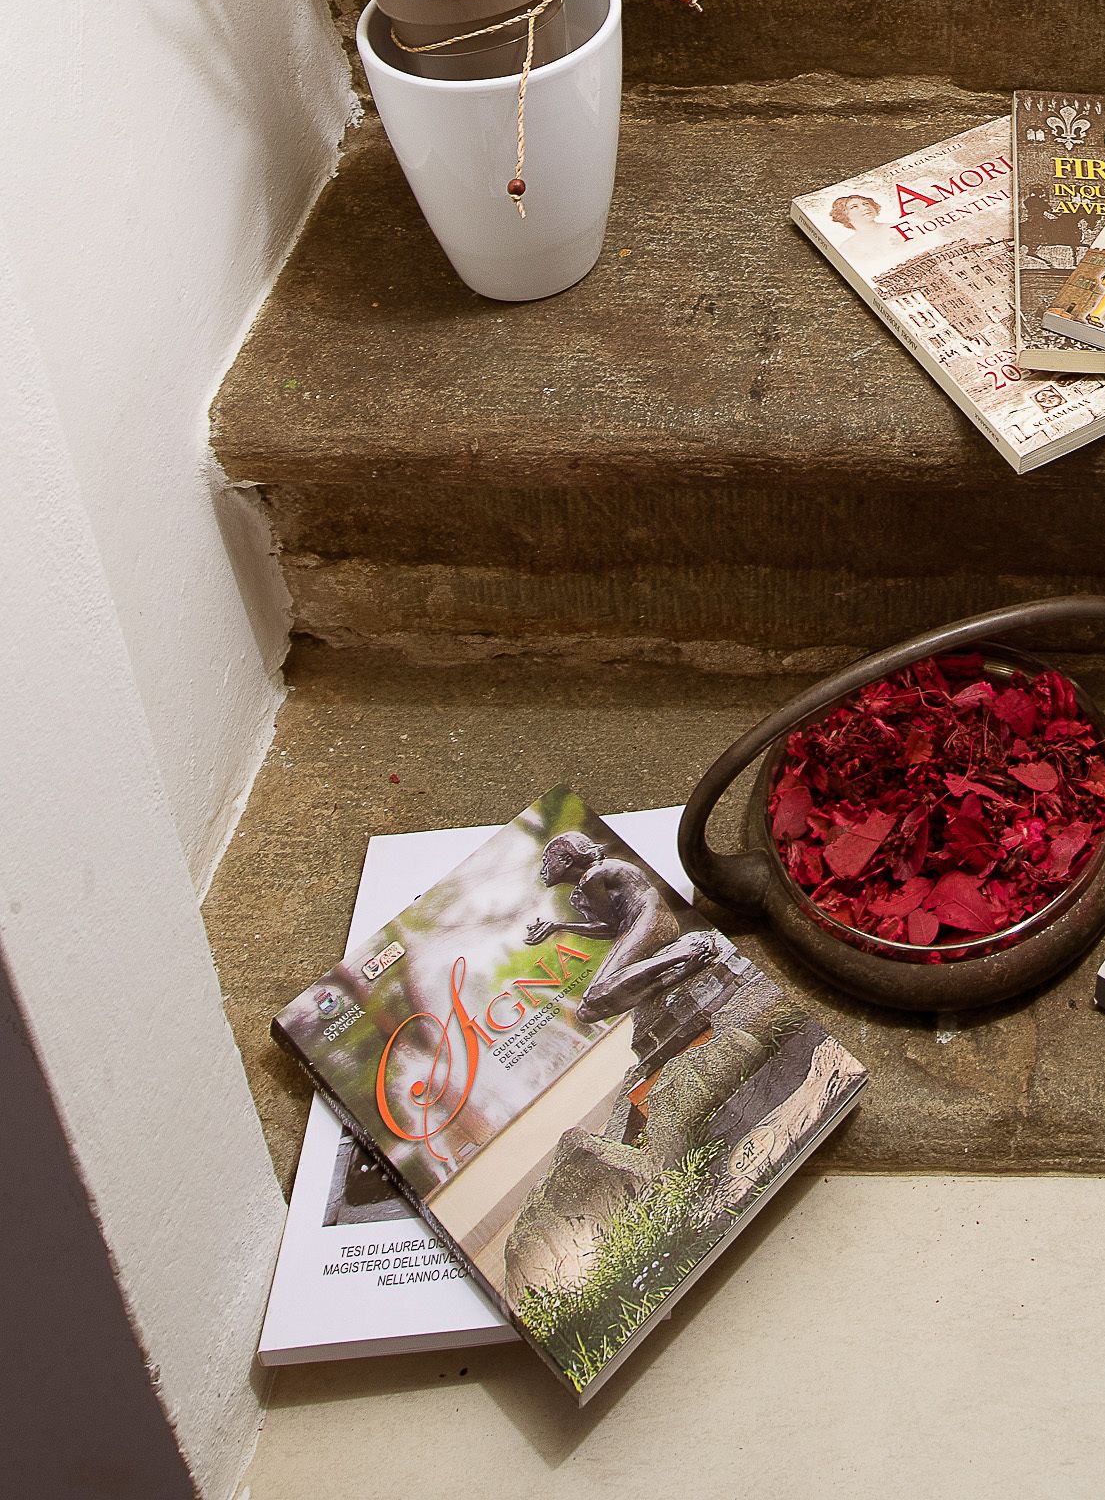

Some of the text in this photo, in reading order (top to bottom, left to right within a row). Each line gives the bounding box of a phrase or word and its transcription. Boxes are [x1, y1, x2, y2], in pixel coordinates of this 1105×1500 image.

[889, 143, 963, 177] LUCA GIANNELLI
[895, 155, 1013, 219] AMORI
[1053, 183, 1077, 197] IN
[890, 189, 1011, 242] FIORENTINI
[976, 345, 1017, 372] AGEN
[983, 364, 1022, 391] 20
[323, 1003, 362, 1037] COMUNE
[326, 1009, 367, 1042] DI SIGNA
[491, 967, 594, 1058] GUIDA STORICO TURISTICA
[498, 1006, 562, 1065] DEL TERRITORIO
[503, 1040, 538, 1072] SIGNESE
[322, 1252, 457, 1277] MAGISTERO DELL'UNIVE
[340, 1244, 366, 1259] TESI
[367, 1243, 380, 1256] DI
[381, 1239, 426, 1254] LAUREA
[377, 1269, 440, 1287] NELL'ANNO
